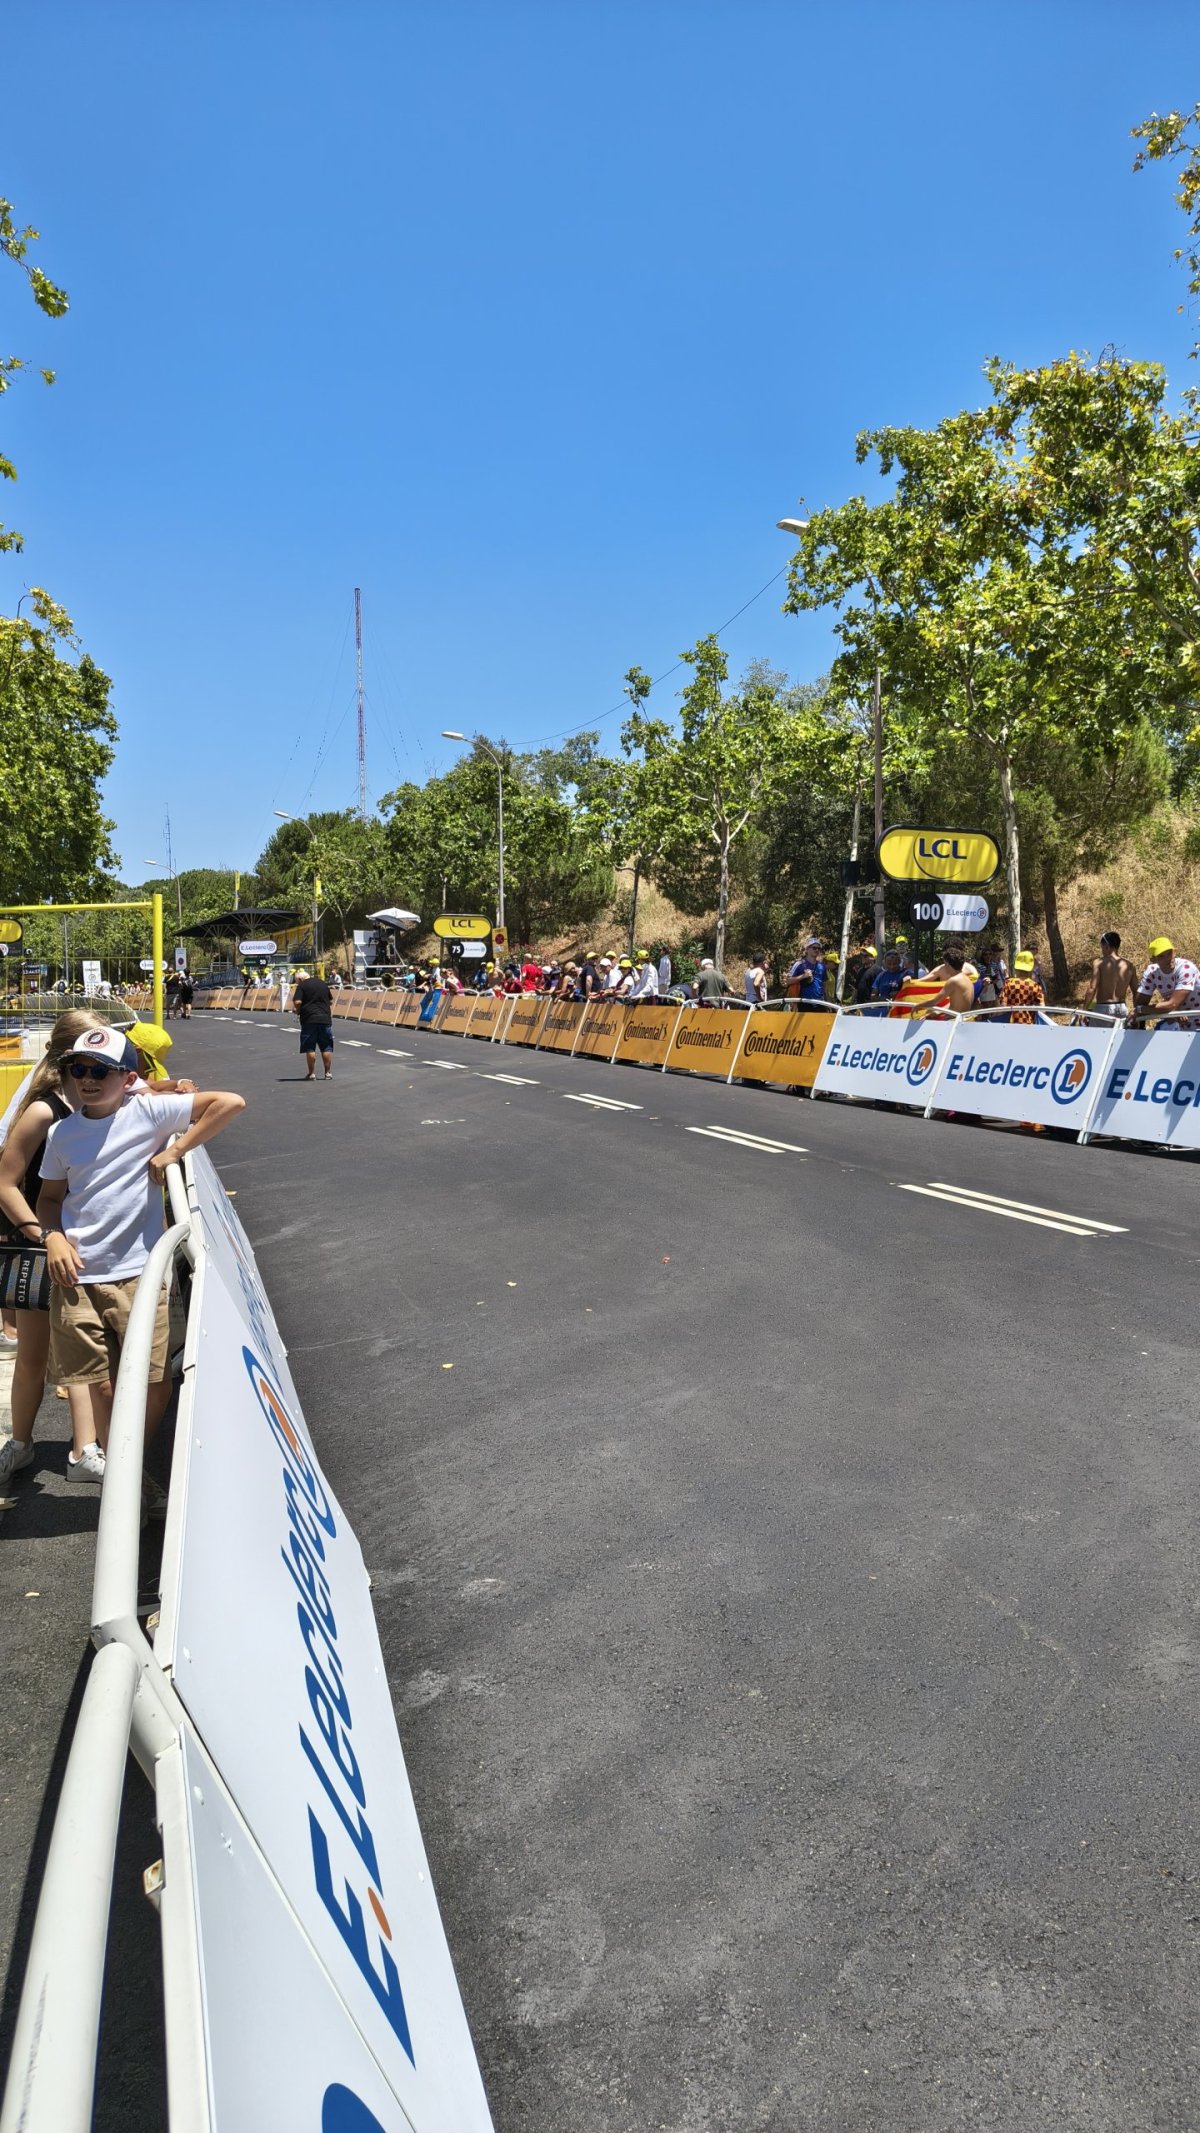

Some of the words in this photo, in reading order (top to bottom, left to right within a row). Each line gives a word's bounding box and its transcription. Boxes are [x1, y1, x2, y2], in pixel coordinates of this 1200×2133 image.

[919, 838, 967, 859] LCL
[913, 903, 940, 920] 100
[946, 908, 978, 917] E.Leclerc
[452, 919, 475, 928] LCL
[451, 945, 461, 954] 75
[581, 1017, 614, 1036] Continental
[624, 1021, 663, 1042] Continental
[676, 1026, 726, 1049] Continental
[744, 1030, 807, 1057] Continental
[827, 1044, 907, 1073] E.Leclerc
[946, 1055, 1050, 1090] E.Leclerc
[18, 1260, 31, 1302] REPETTO
[281, 1467, 416, 2071] E.Leclerc
